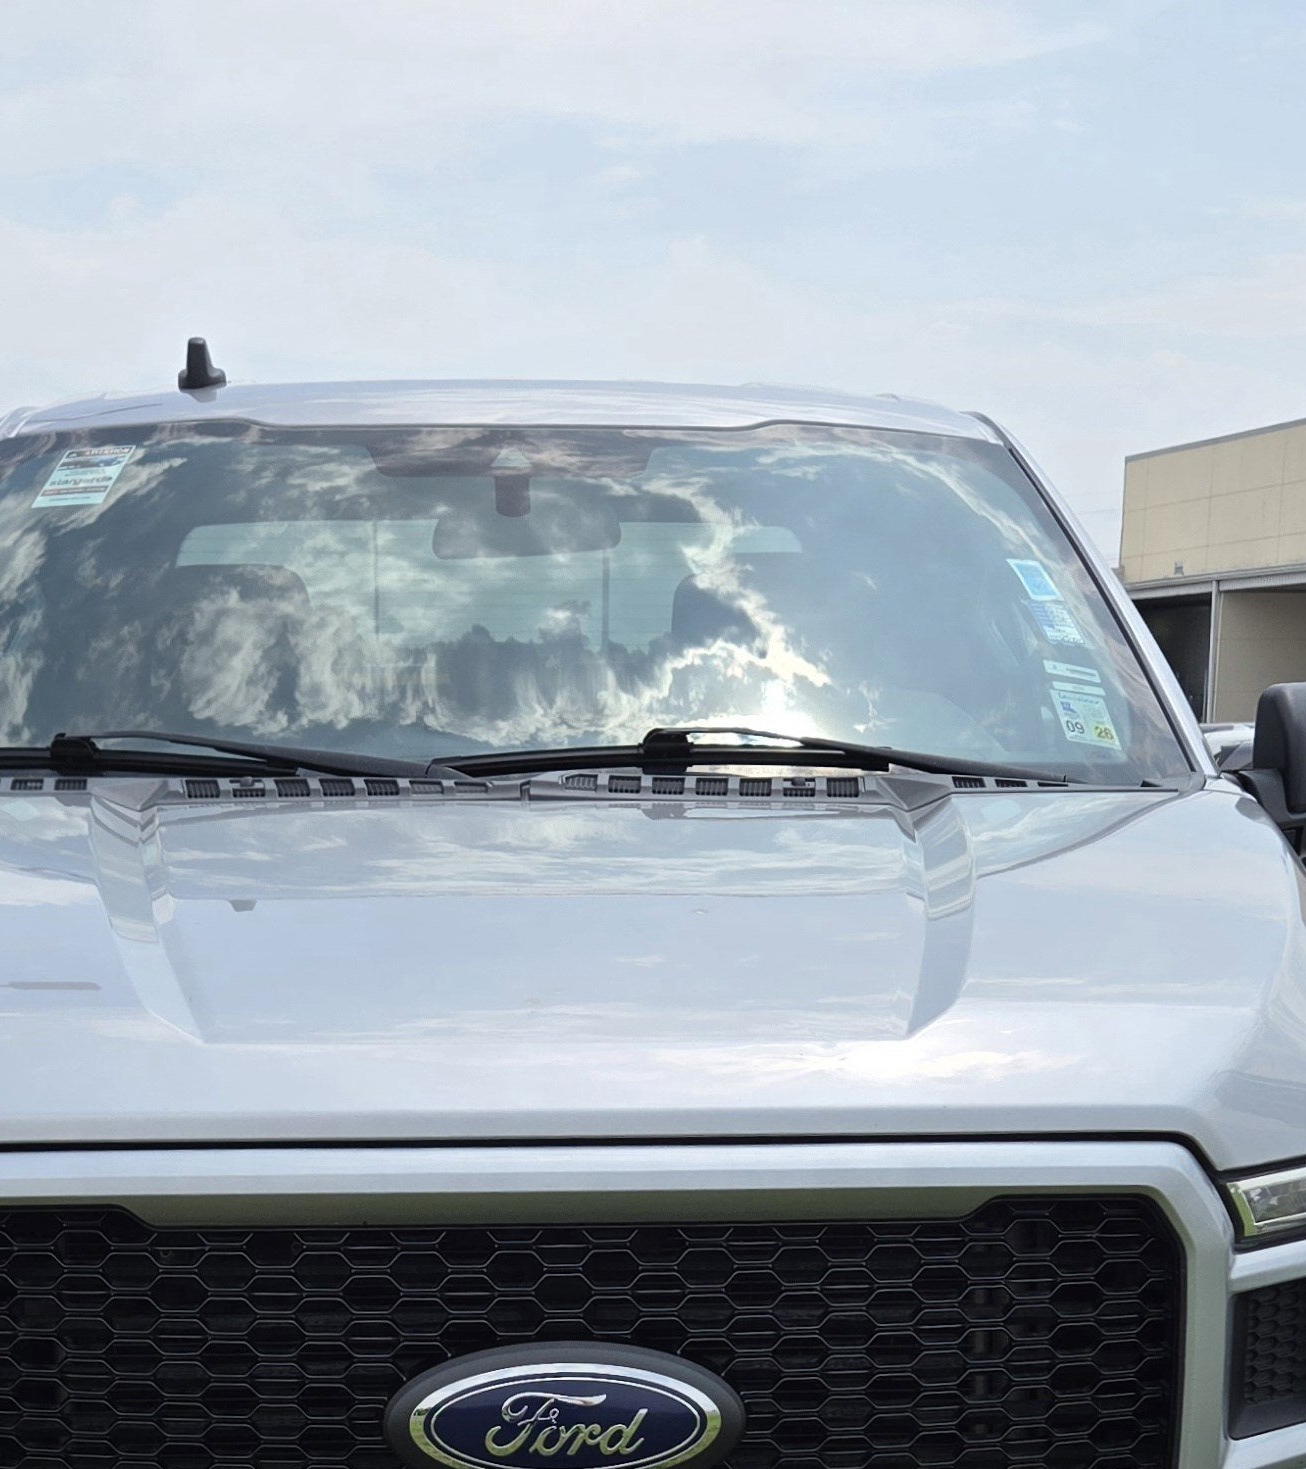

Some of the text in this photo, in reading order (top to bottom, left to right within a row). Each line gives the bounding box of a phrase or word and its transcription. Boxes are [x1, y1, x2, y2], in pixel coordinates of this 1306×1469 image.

[1065, 719, 1114, 740] 09 26
[484, 1391, 649, 1456] Ford
